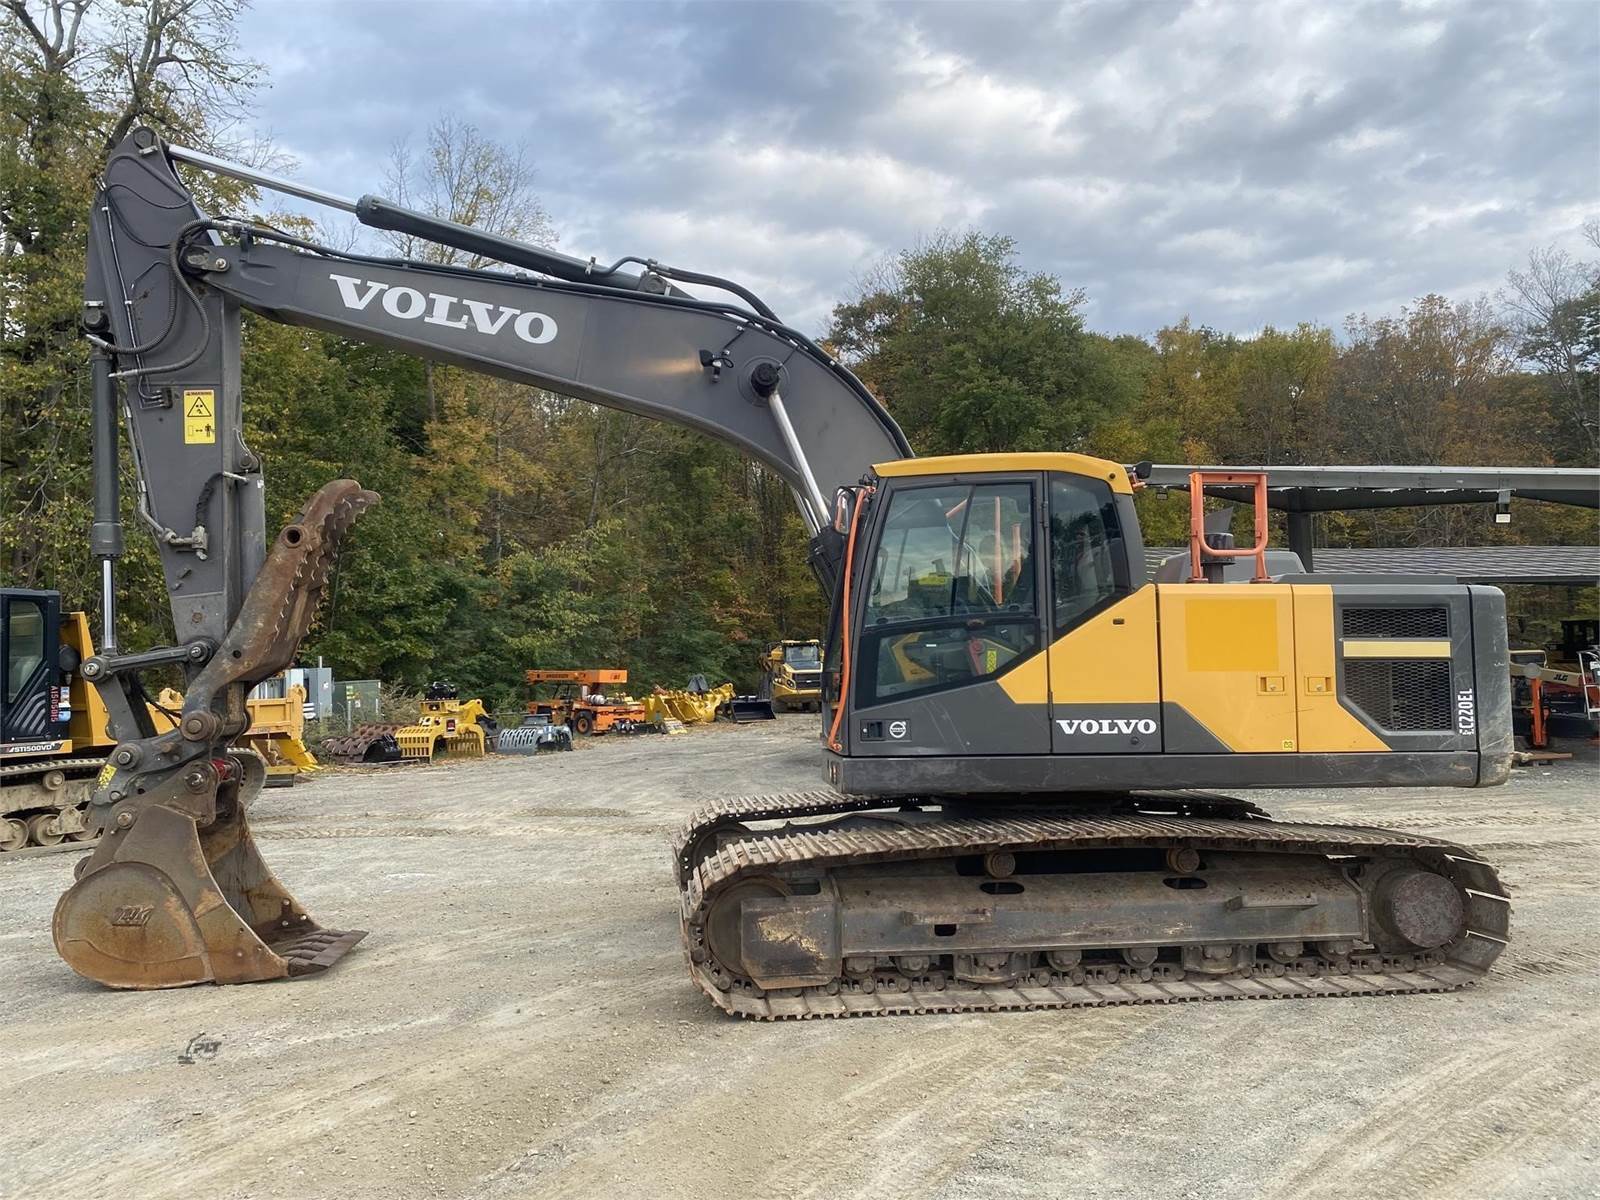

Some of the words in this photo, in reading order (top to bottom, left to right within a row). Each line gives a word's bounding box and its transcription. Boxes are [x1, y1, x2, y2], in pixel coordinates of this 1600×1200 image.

[329, 273, 558, 344] VOLVO
[1553, 673, 1569, 682] JLG
[1056, 719, 1157, 735] VOLVO
[1457, 688, 1475, 736] EC220EL
